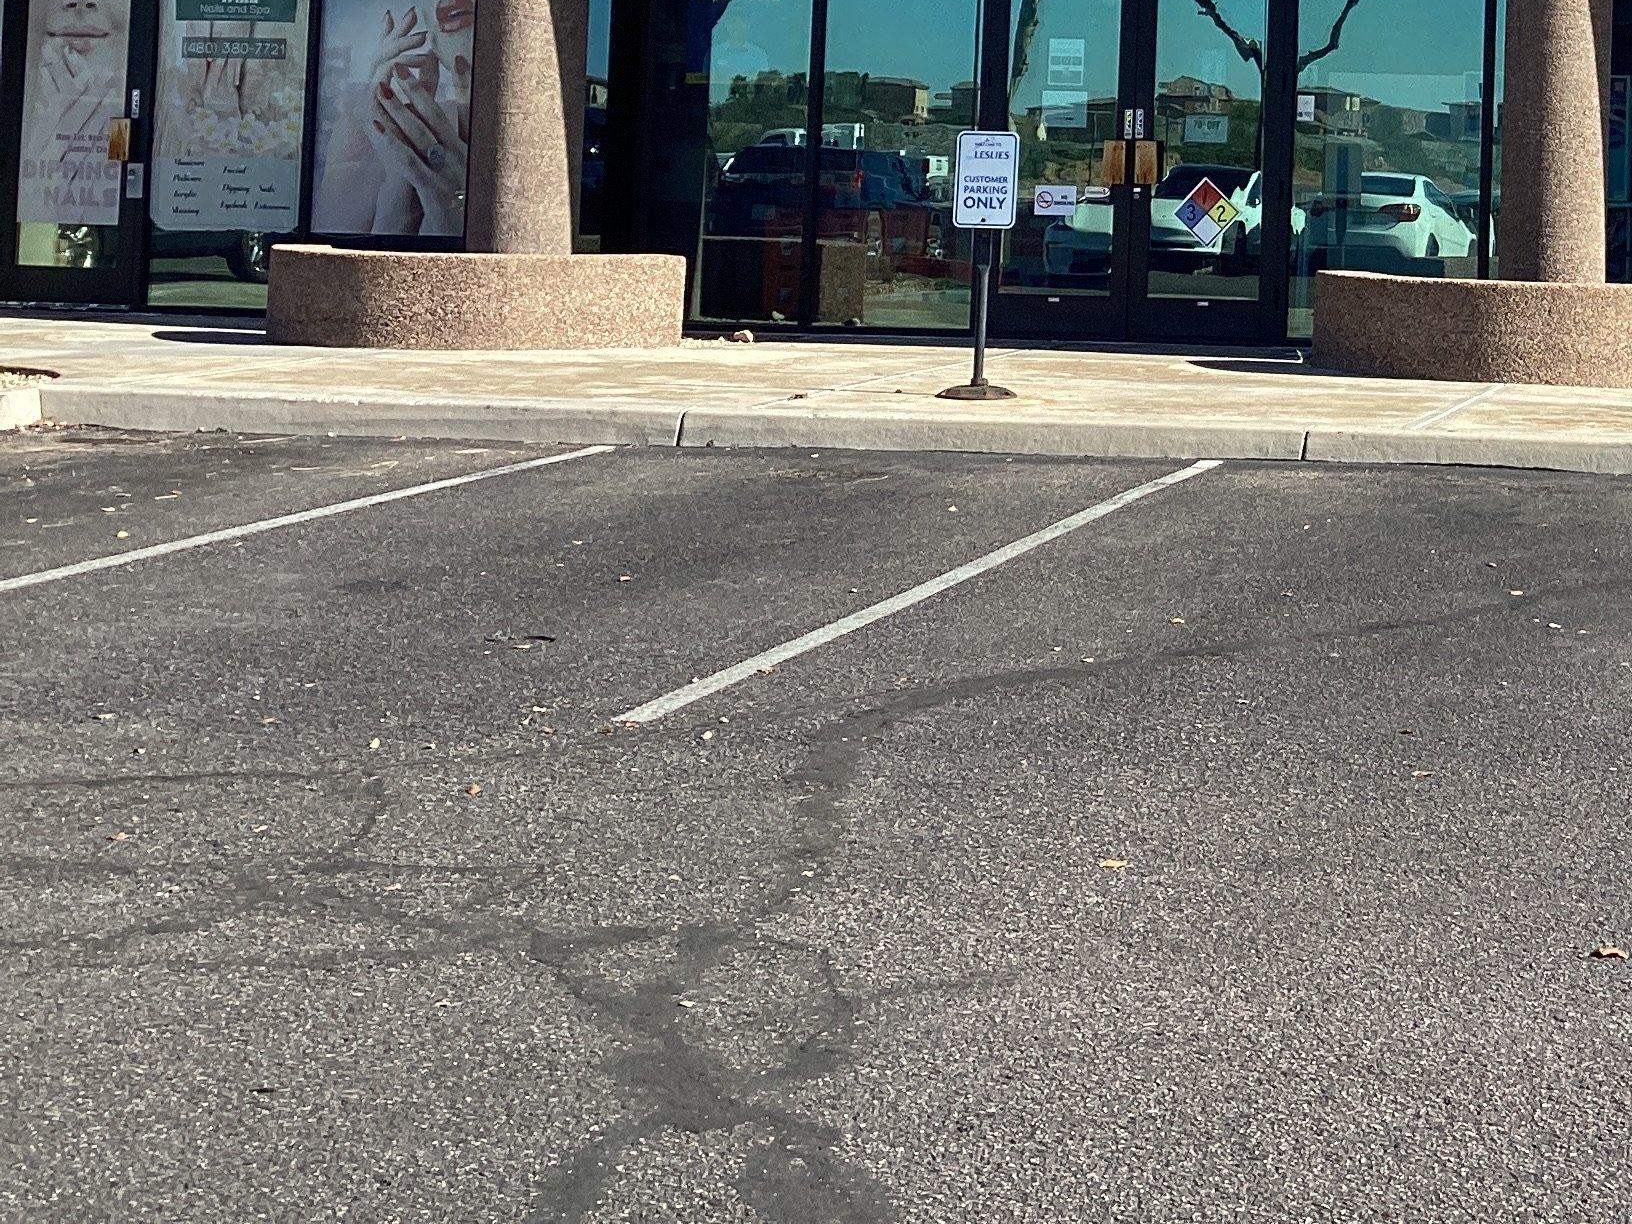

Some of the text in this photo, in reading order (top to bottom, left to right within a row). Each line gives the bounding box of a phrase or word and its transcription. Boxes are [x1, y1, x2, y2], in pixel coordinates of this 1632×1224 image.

[200, 3, 271, 16] Nails and Spa
[183, 42, 286, 56] (480) 380-7721
[964, 176, 1008, 185] CUSTOMER
[43, 186, 119, 208] NAILS
[964, 185, 1008, 195] PARKING
[963, 196, 1007, 210] ONLY
[1186, 203, 1198, 221] 3
[1216, 204, 1228, 223] 2
